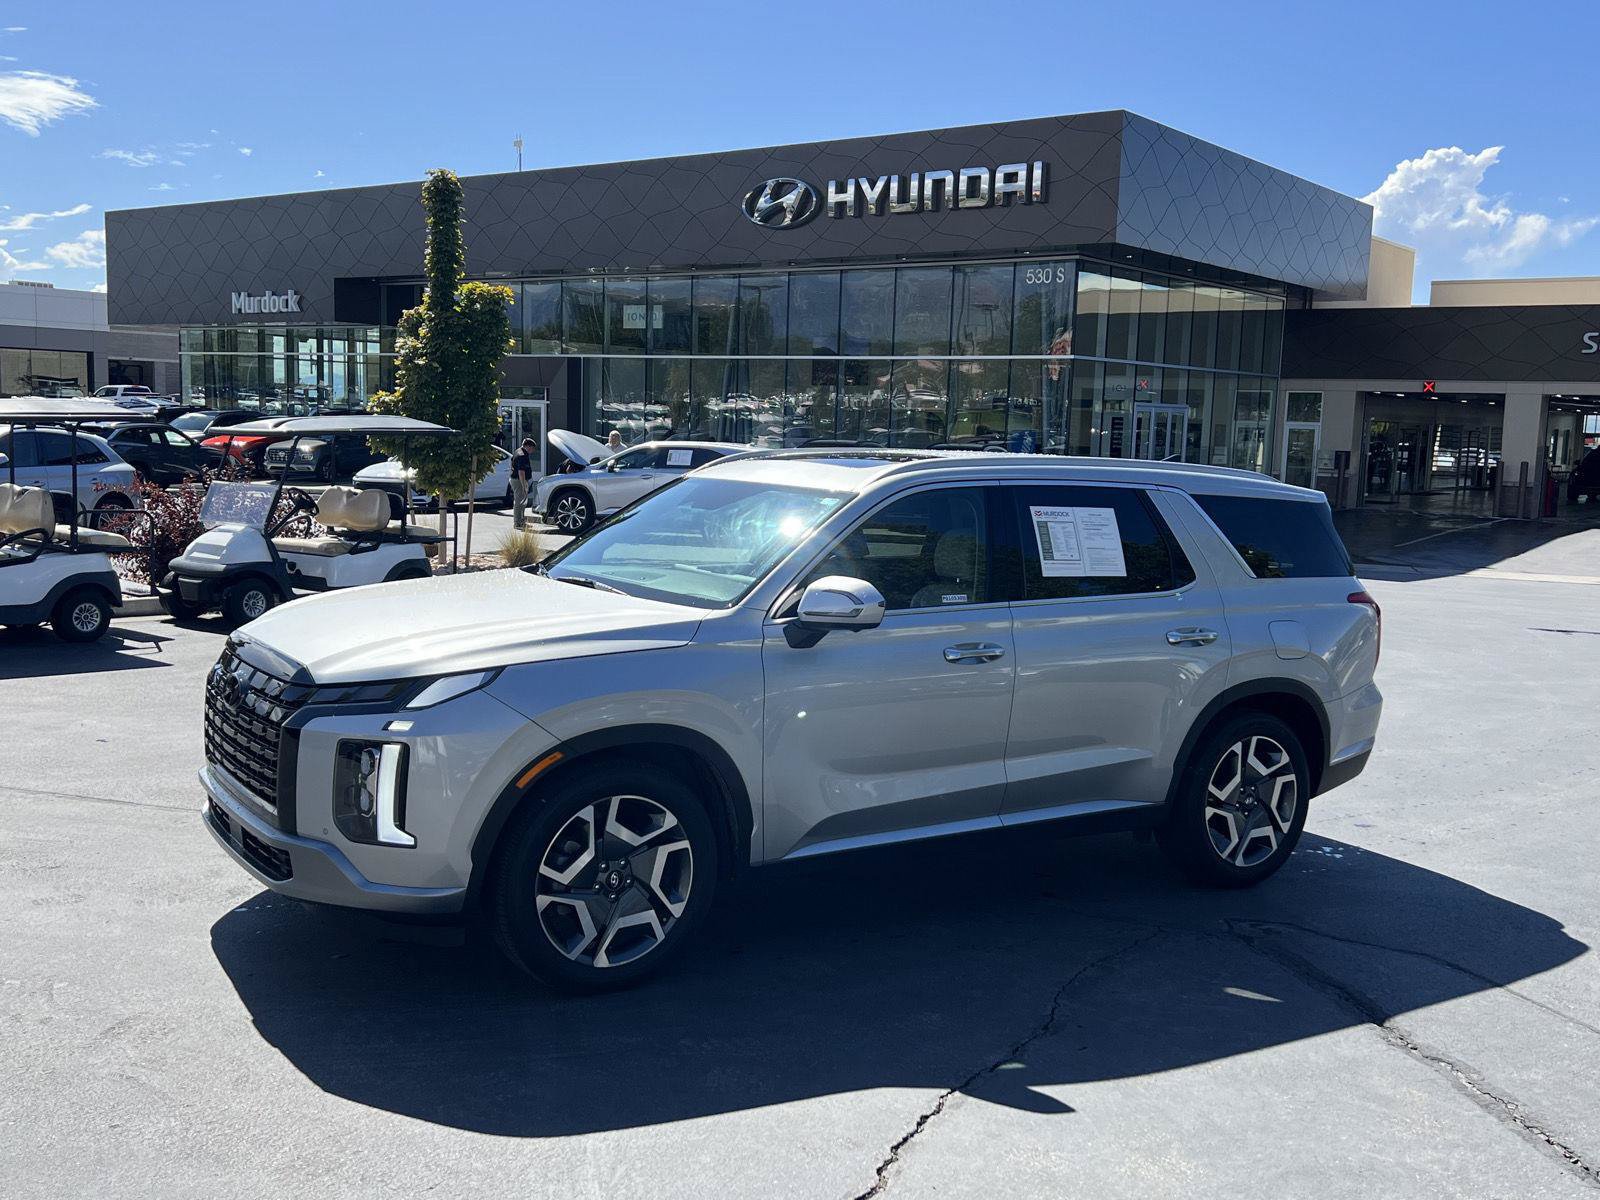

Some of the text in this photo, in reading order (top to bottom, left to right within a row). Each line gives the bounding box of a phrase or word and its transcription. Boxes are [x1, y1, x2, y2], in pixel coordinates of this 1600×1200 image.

[828, 160, 1046, 218] HYUNDAI
[1025, 267, 1065, 284] 530 S
[231, 289, 301, 314] Murdock
[1581, 332, 1600, 354] S
